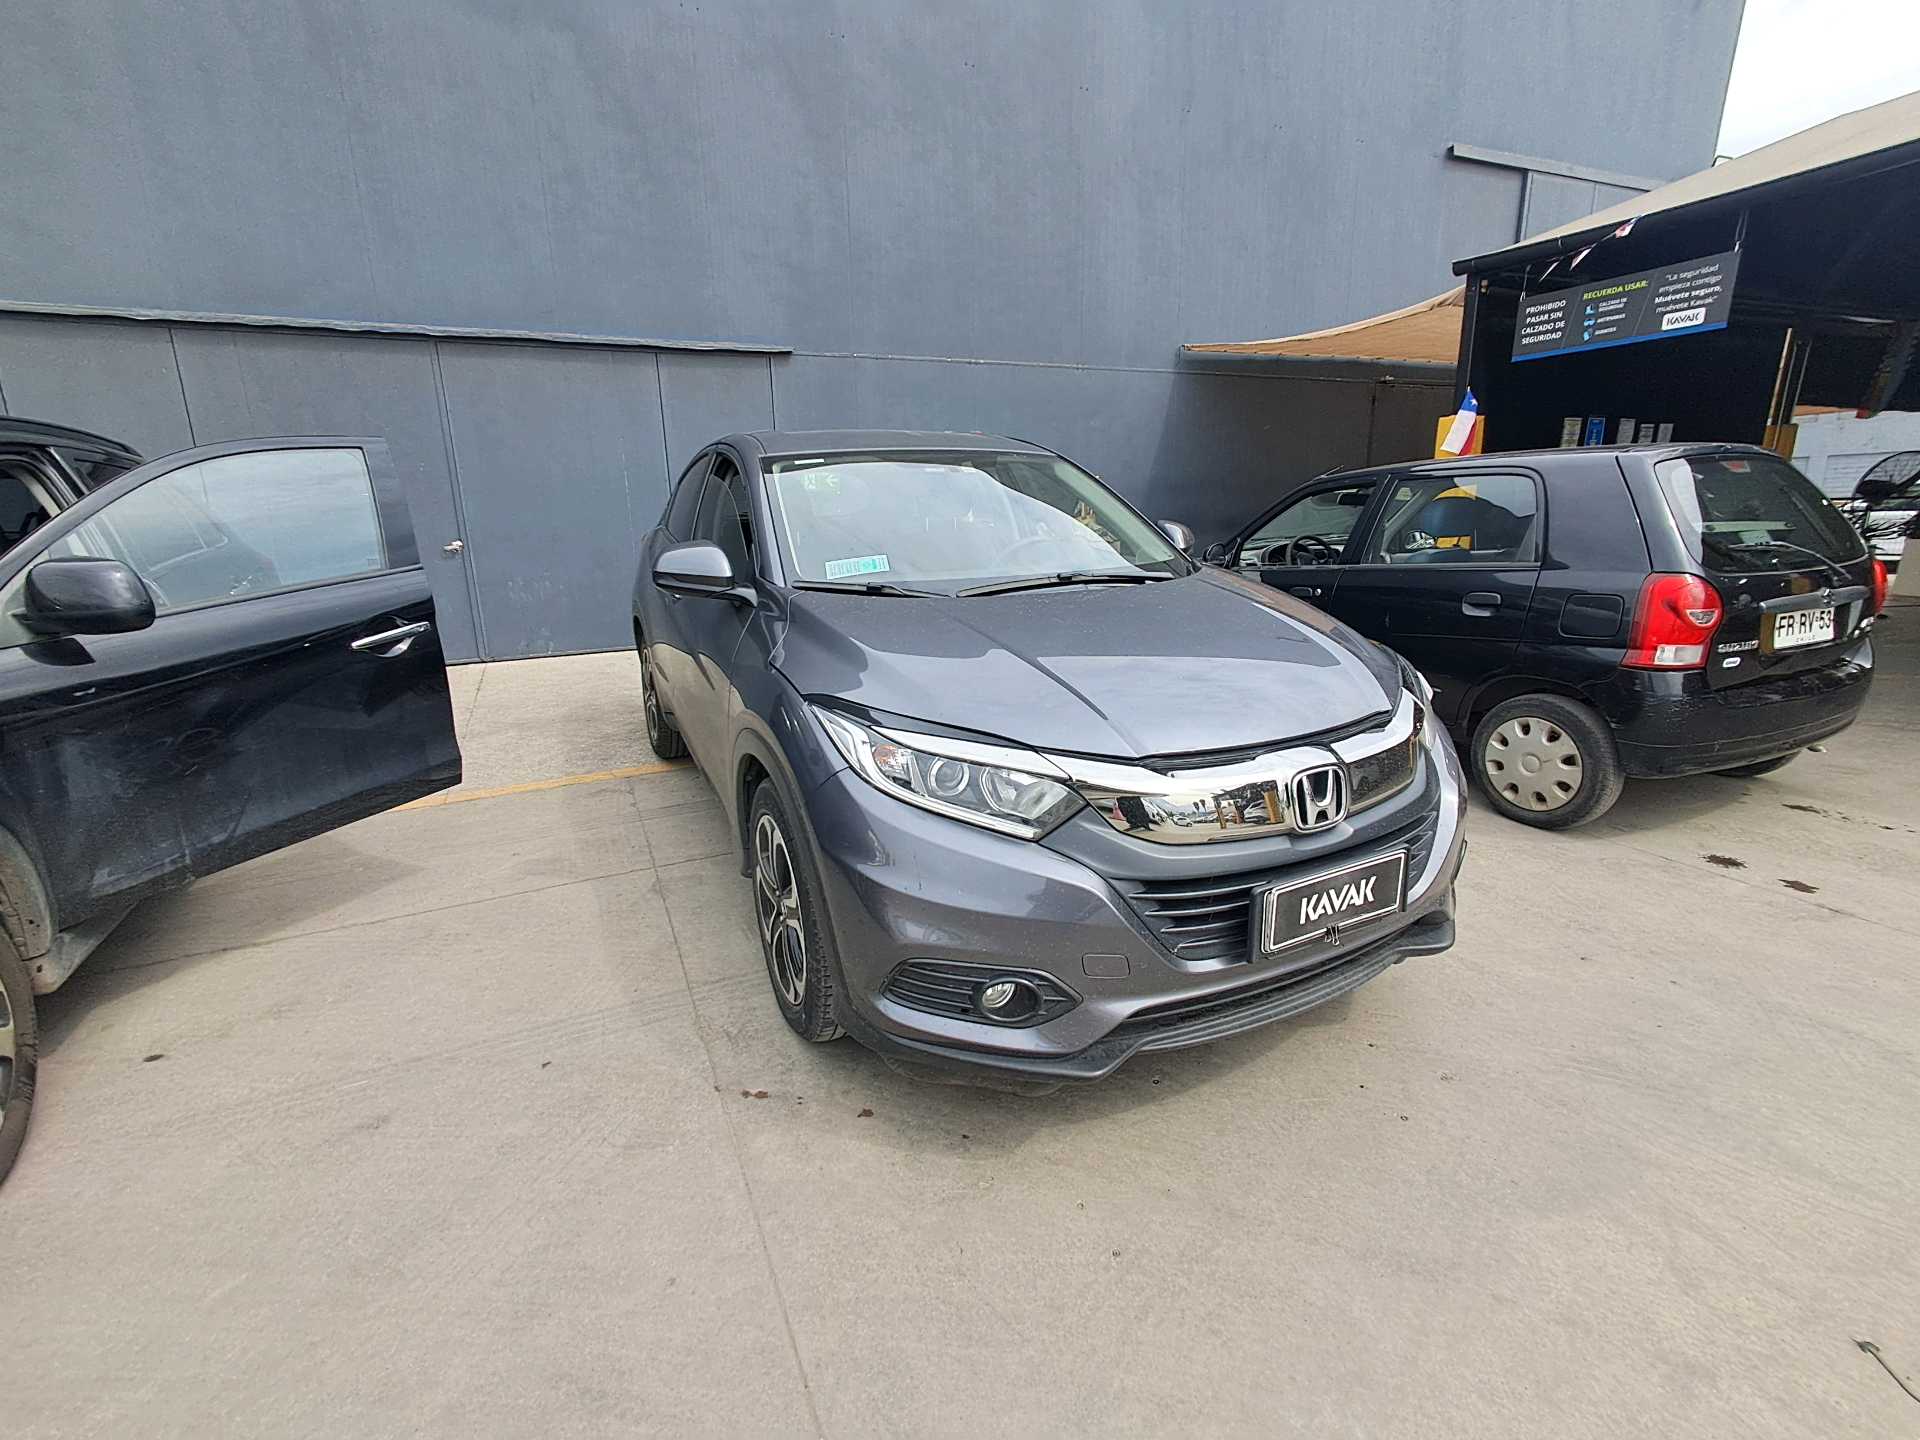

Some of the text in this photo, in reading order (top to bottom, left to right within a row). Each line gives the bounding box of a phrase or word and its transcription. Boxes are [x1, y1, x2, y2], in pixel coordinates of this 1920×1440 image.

[1583, 286, 1623, 300] RECUERDA
[1526, 300, 1567, 315] PROHIBIDO
[1526, 311, 1563, 324] PASAR SIN
[1666, 312, 1701, 326] KAVAK
[1521, 320, 1566, 335] CALZADO DE
[1521, 331, 1562, 345] SEGURIDAD
[1299, 875, 1377, 925] KAVAK
